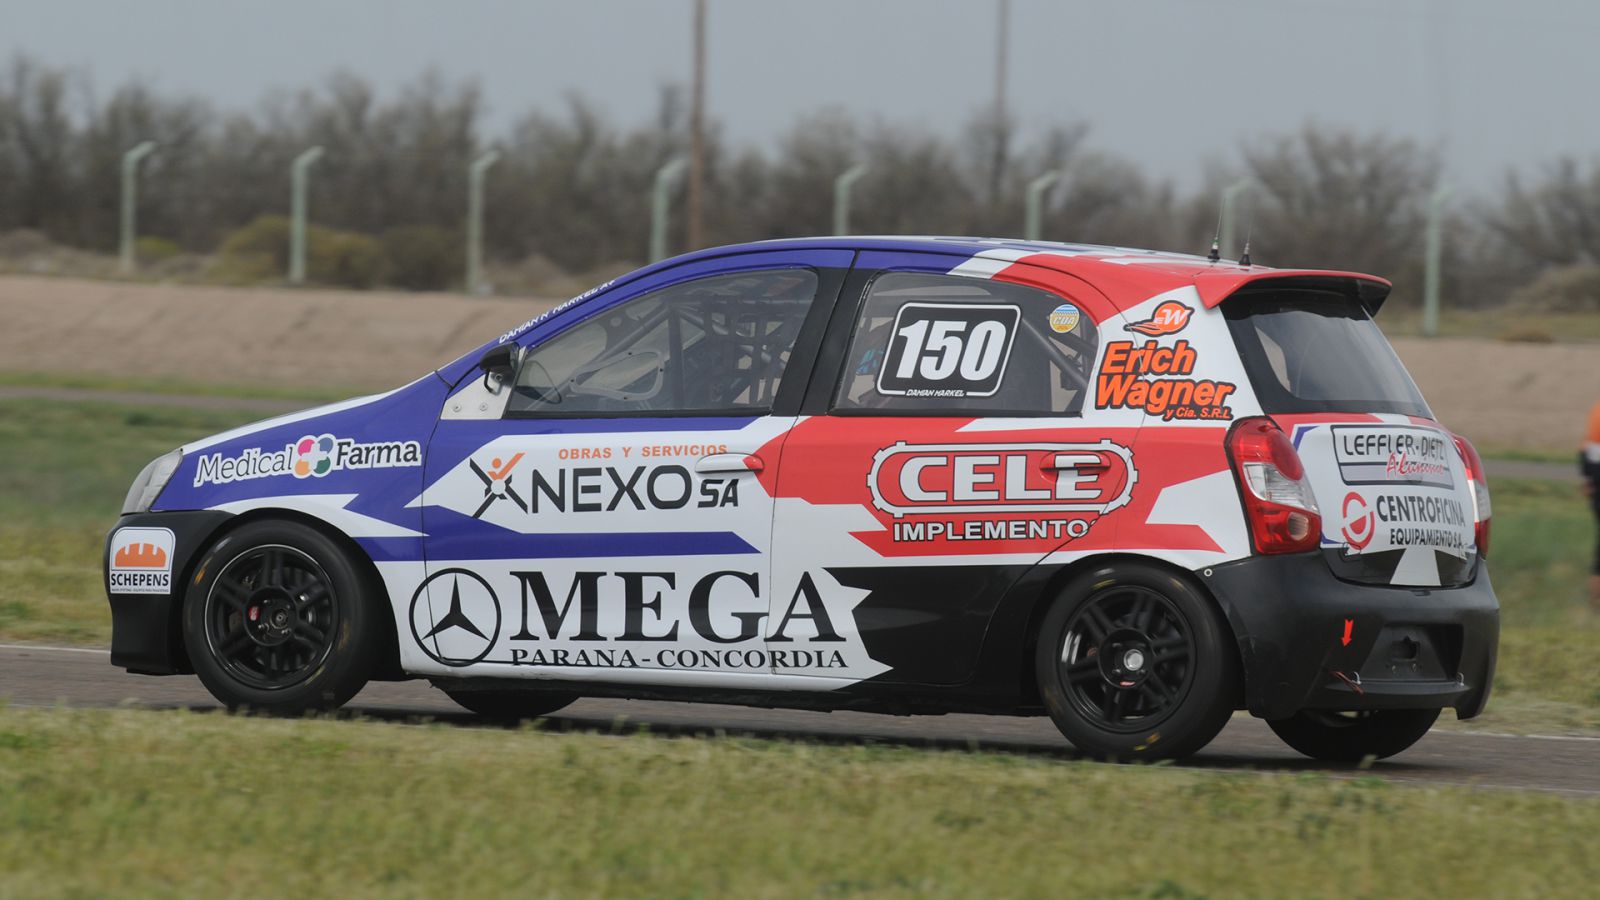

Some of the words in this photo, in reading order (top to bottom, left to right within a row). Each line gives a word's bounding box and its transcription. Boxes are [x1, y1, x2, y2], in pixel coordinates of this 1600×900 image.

[896, 319, 1007, 381] 150
[1100, 340, 1196, 374] Erich
[1096, 373, 1235, 414] Wagner
[1165, 408, 1175, 420] y
[197, 446, 293, 483] Medical
[336, 441, 420, 467] Farma
[558, 447, 612, 460] OBRAS
[622, 446, 633, 458] Y
[642, 444, 728, 457] SERVICIOS
[532, 464, 693, 514] NEXO
[697, 478, 740, 509] SA
[899, 454, 1103, 502] CELE
[1376, 495, 1466, 527] CENTROFICINA
[893, 518, 1097, 542] IMPLEMENTO
[1390, 528, 1452, 547] EQUIPAMIENTO
[110, 573, 169, 587] SCHEPENS
[509, 570, 847, 645] MEGA
